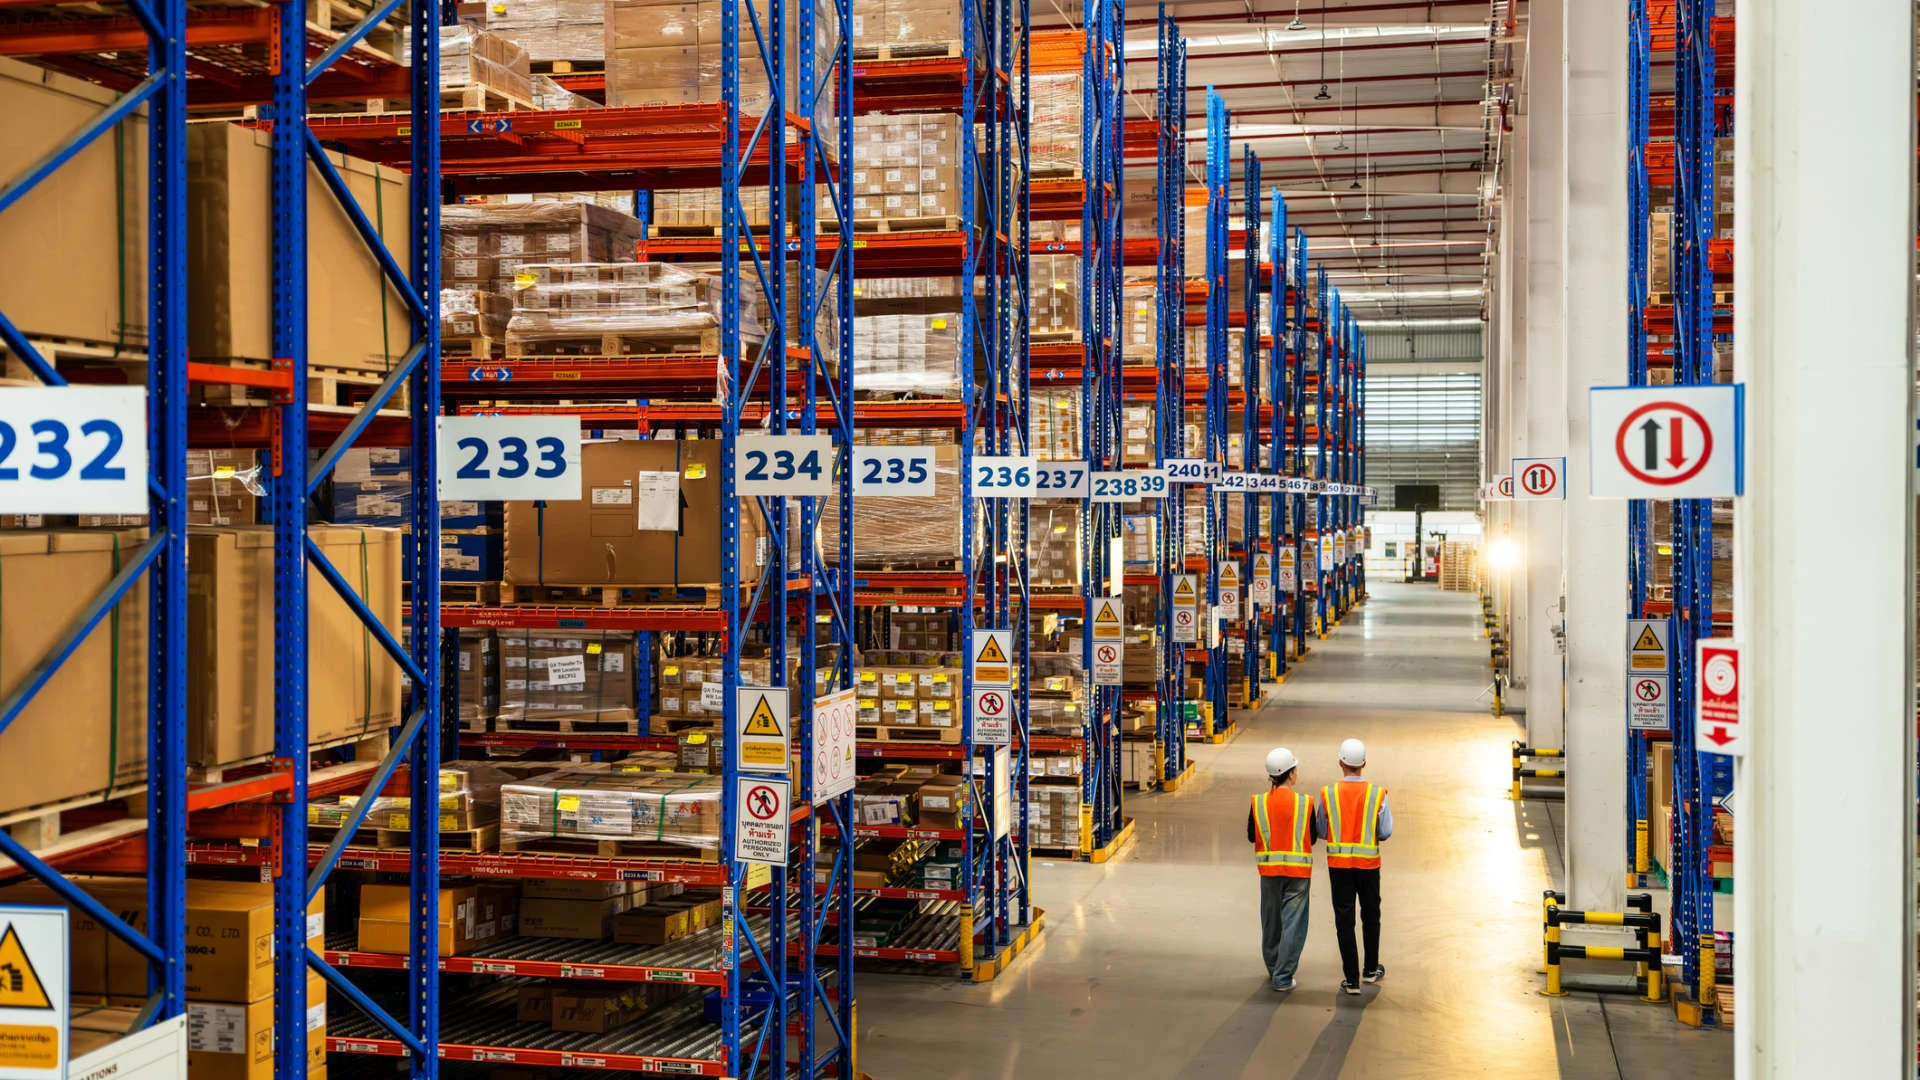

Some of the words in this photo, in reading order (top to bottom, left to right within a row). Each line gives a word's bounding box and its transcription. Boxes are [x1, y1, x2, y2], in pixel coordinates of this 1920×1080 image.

[457, 436, 567, 479] 233
[744, 449, 822, 481] 234
[862, 457, 928, 484] 235
[977, 466, 1031, 487] 236
[1168, 463, 1201, 478] 240
[1036, 470, 1084, 489] 237
[1094, 478, 1137, 496] 238
[1140, 475, 1165, 492] 39
[1216, 476, 1244, 487] 42
[1260, 478, 1276, 487] 44
[1279, 479, 1286, 488] 5
[1288, 480, 1301, 489] 46
[742, 838, 782, 847] AUTHORIZED
[743, 844, 781, 853] PERSONNEL
